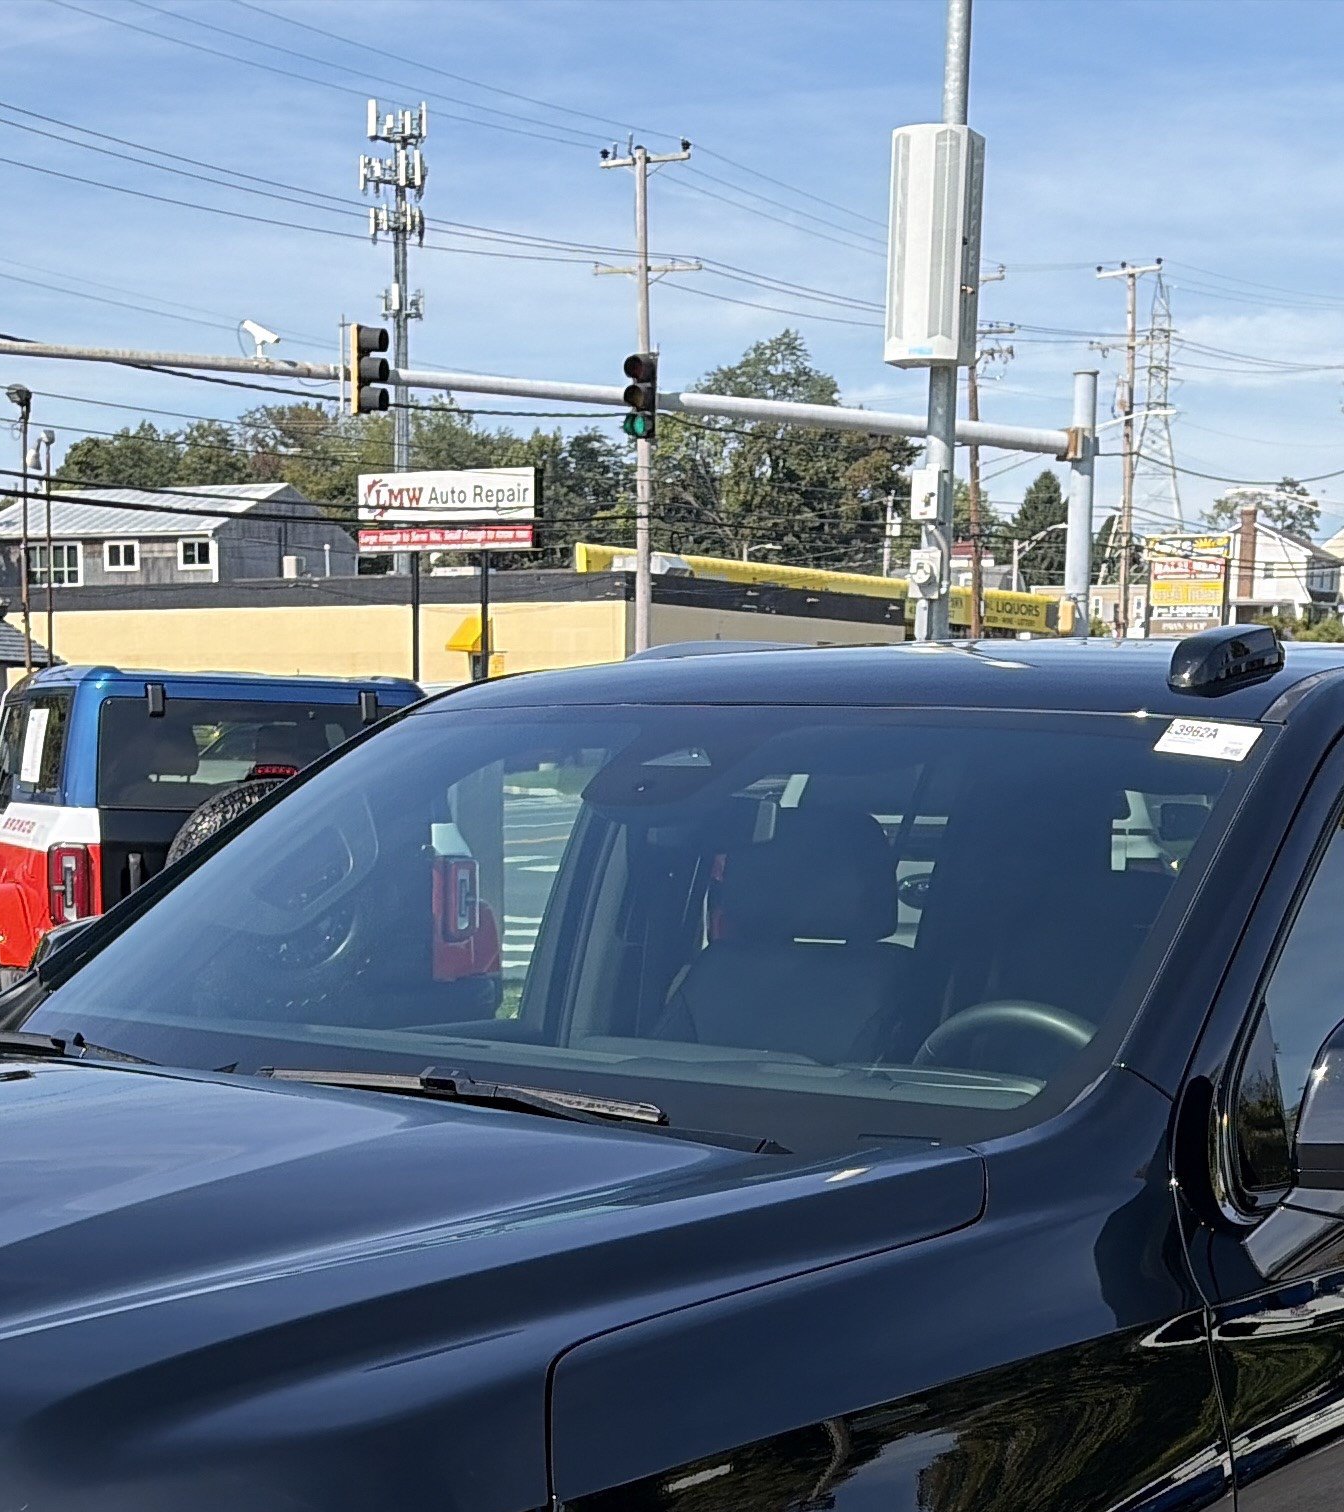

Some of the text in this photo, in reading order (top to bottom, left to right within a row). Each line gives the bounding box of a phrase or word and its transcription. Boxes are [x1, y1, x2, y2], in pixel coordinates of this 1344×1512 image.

[375, 483, 529, 508] LMW Auto Repair
[996, 602, 1040, 617] LIQUORS
